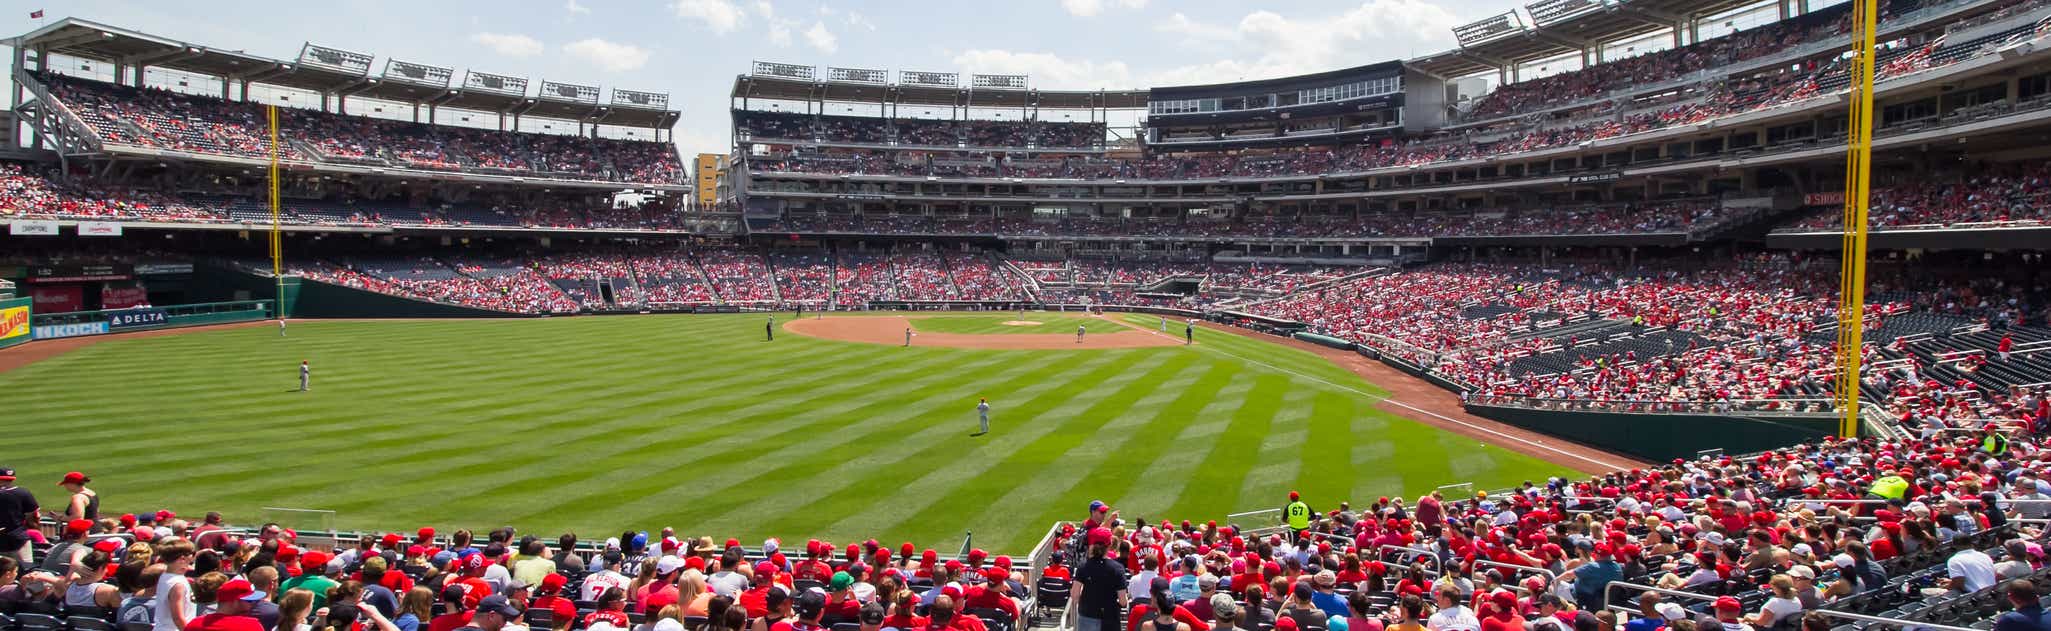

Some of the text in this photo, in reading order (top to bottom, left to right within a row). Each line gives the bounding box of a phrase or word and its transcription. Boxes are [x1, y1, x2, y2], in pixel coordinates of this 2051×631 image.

[124, 313, 164, 323] DELTA
[54, 322, 103, 337] KOCH
[1292, 506, 1304, 516] 67
[591, 586, 604, 600] 7
